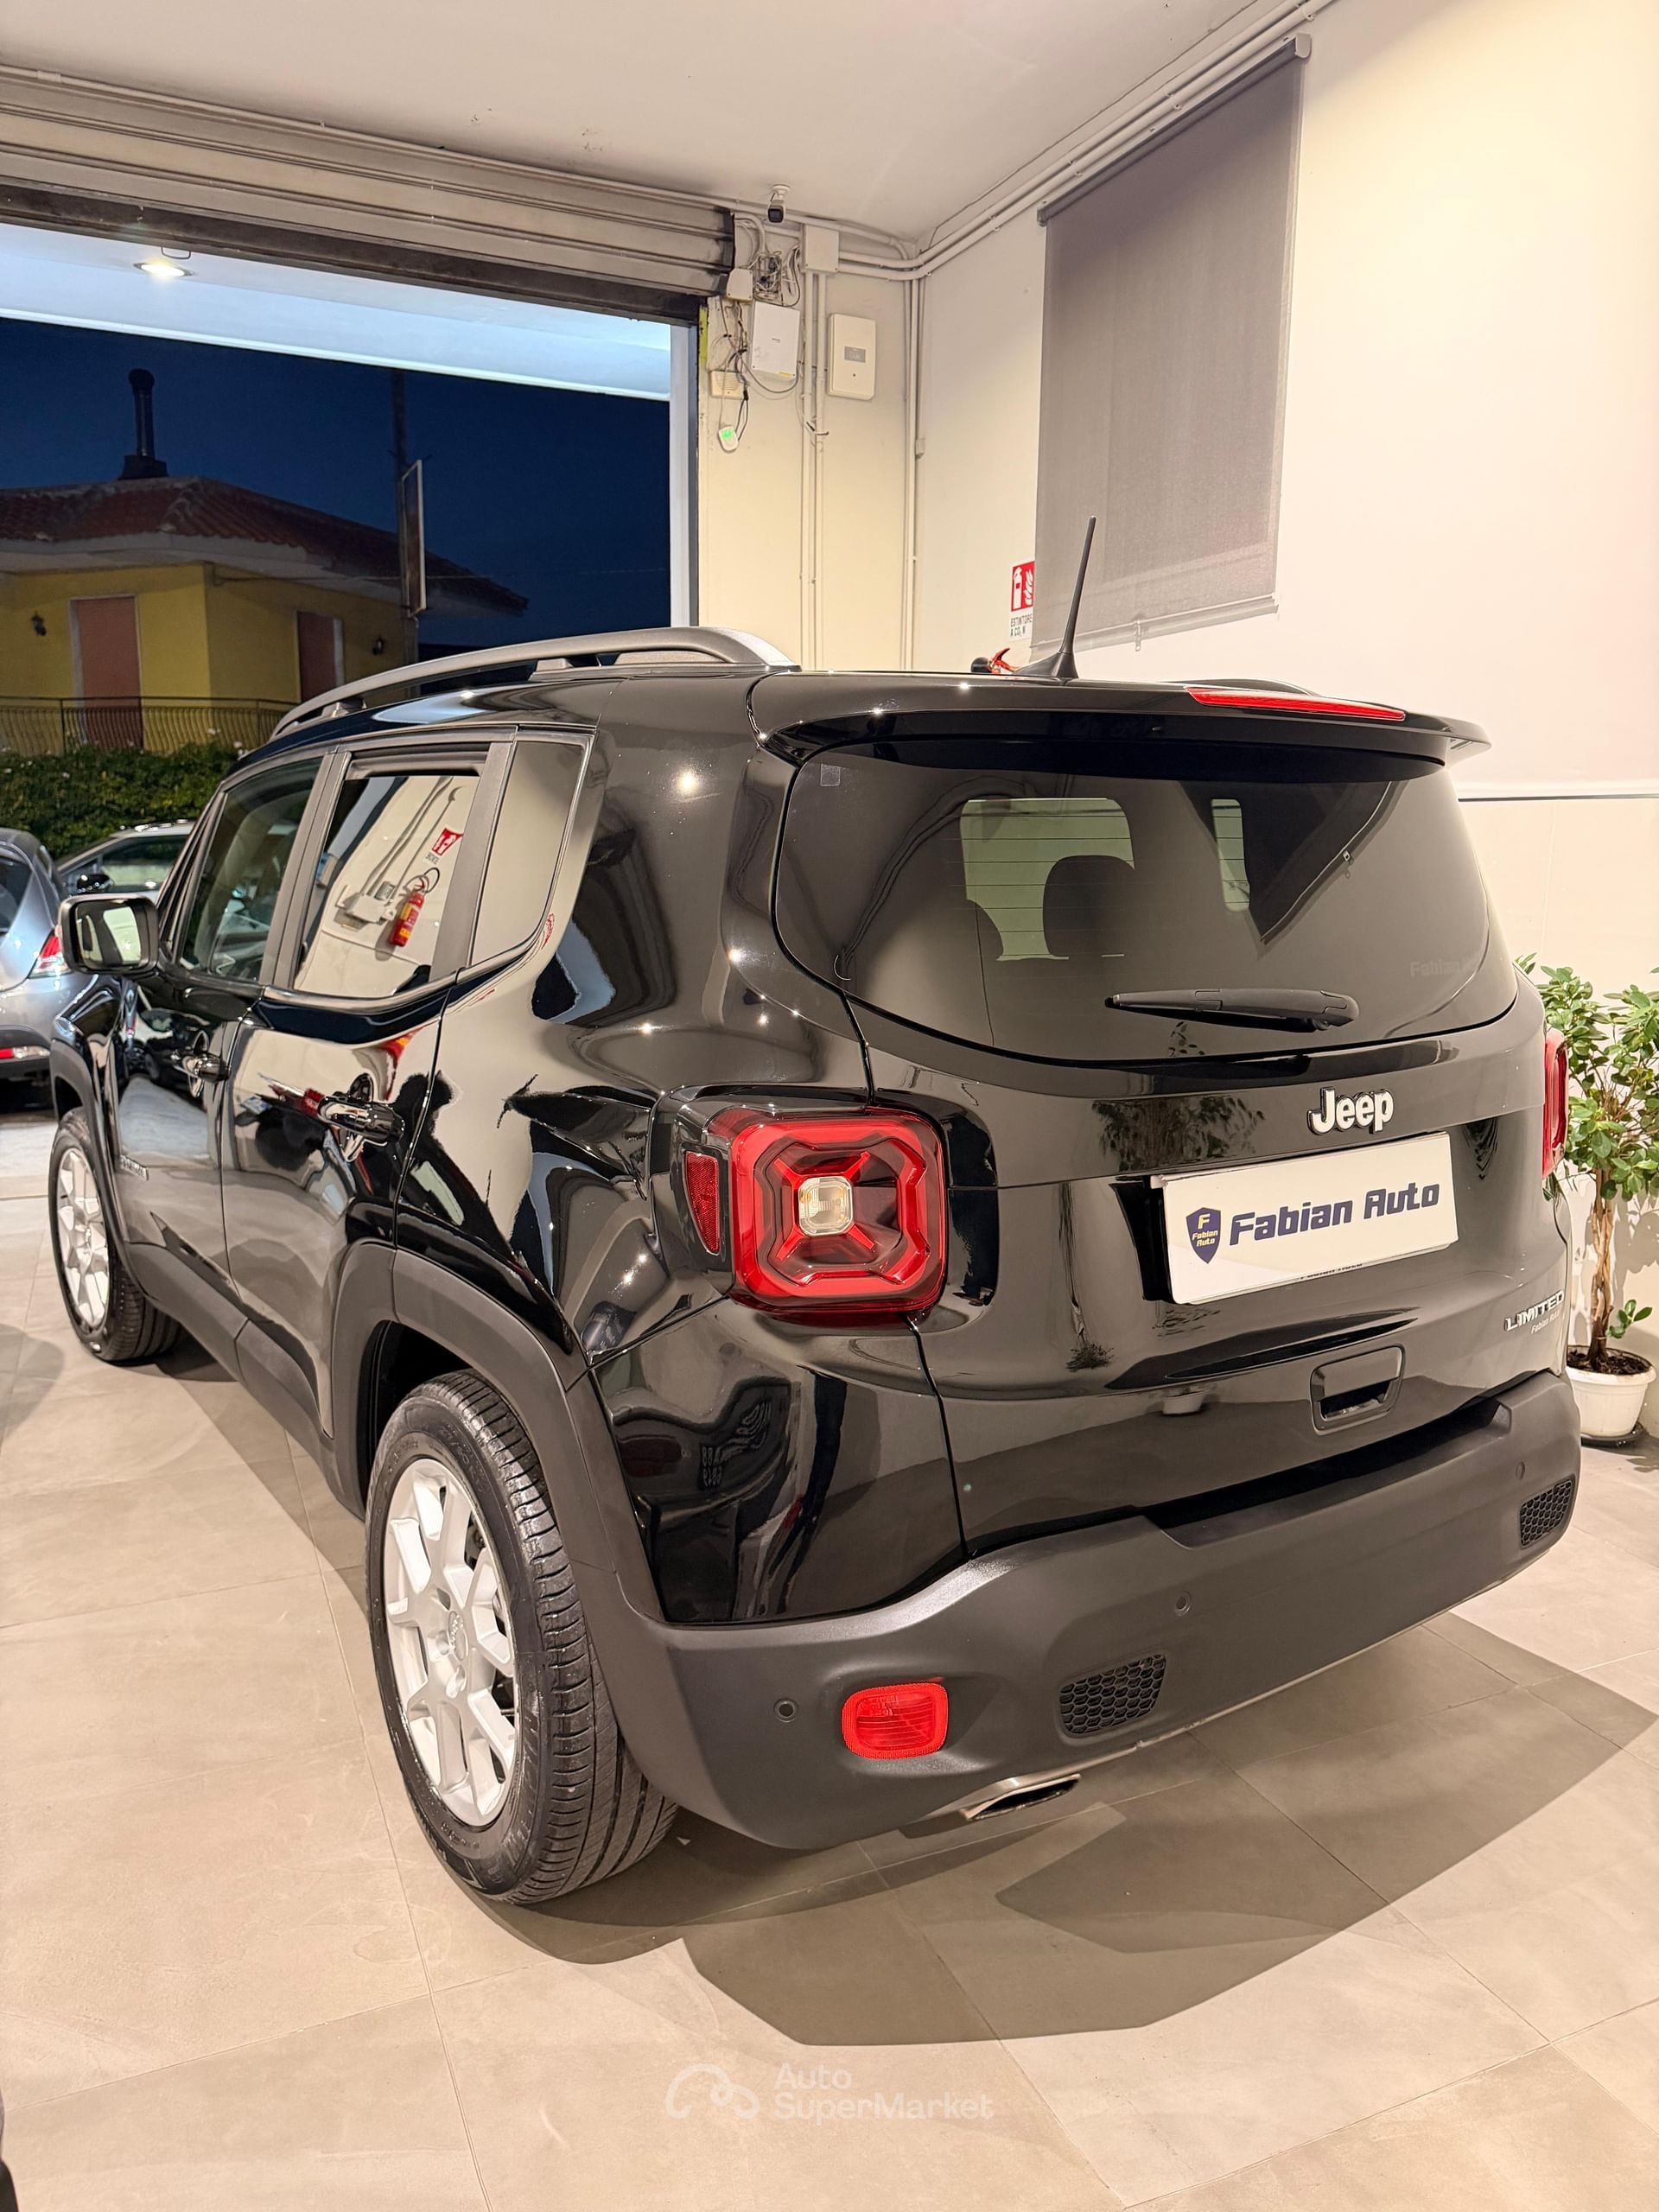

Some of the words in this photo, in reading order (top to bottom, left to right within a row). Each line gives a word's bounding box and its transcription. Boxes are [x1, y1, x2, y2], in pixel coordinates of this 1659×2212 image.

[1307, 1087, 1394, 1135] Jeep
[1198, 1213, 1211, 1230] F
[1230, 1202, 1353, 1246] Fabian
[1363, 1182, 1440, 1219] Auto
[1192, 1230, 1218, 1241] Fabian
[1197, 1238, 1216, 1247] Auto
[1504, 1289, 1565, 1332] LIMITED
